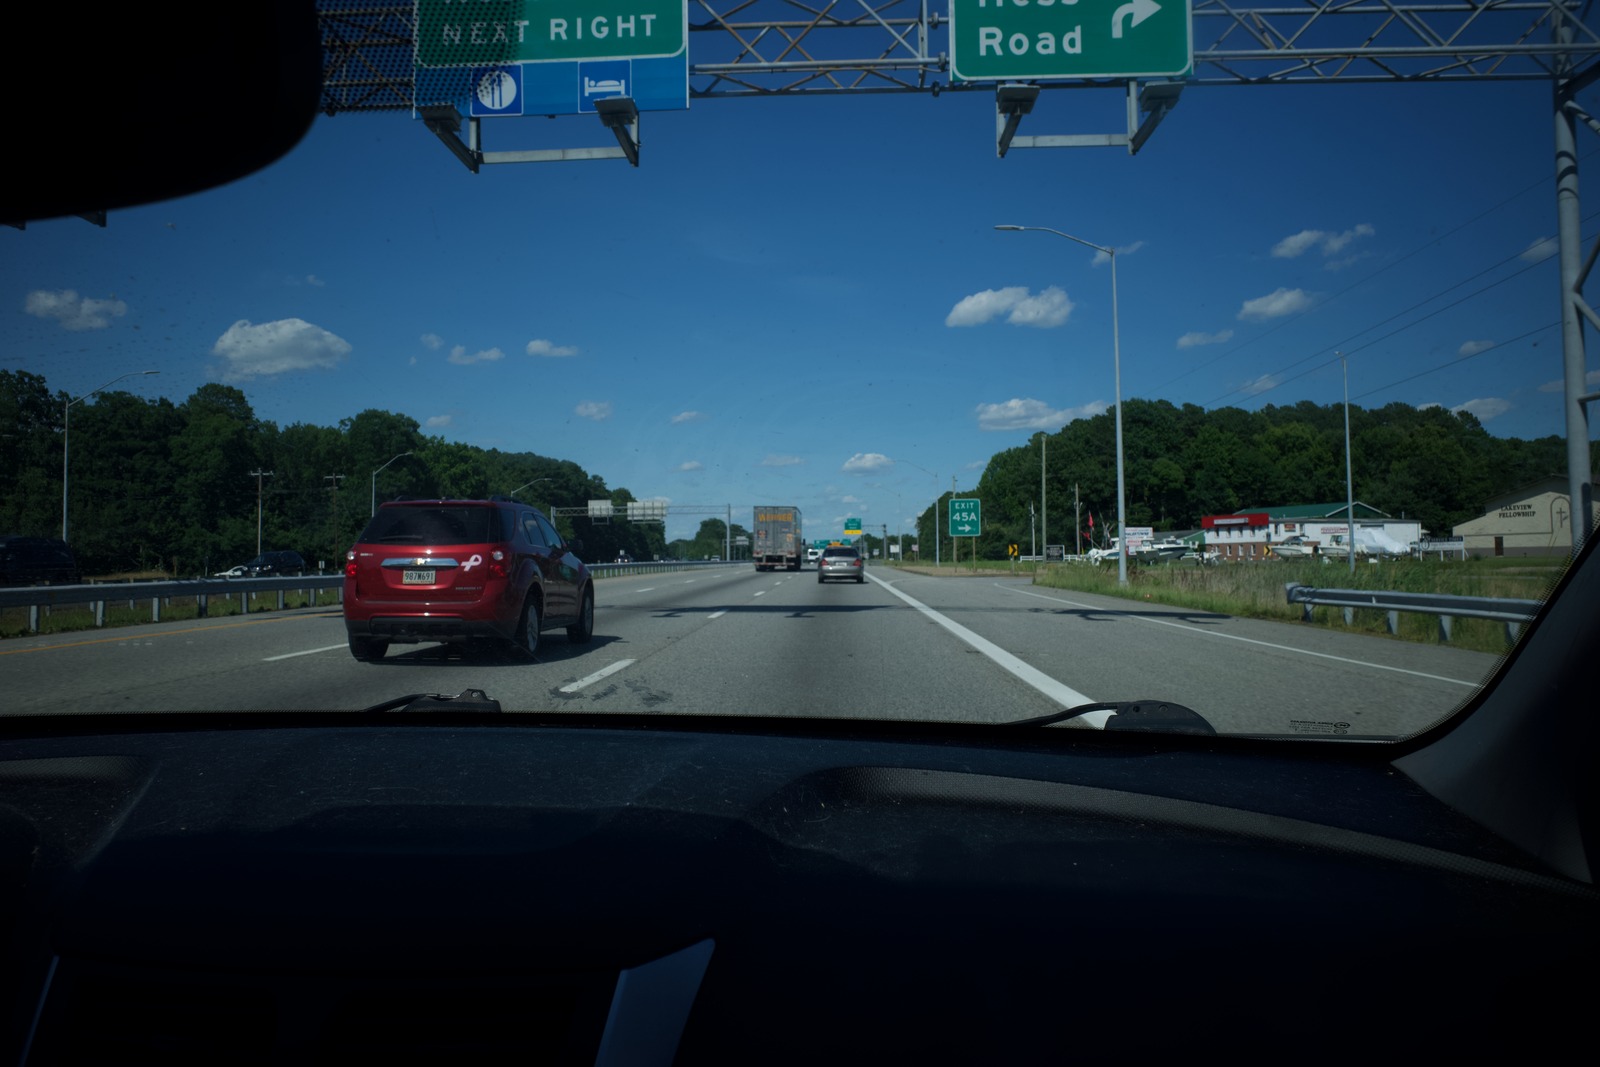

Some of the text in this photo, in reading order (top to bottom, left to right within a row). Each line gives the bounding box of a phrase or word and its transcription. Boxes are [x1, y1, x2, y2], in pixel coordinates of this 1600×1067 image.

[442, 14, 657, 46] NEXT RIGHT
[979, 25, 1082, 57] Road
[955, 502, 974, 510] EXIT
[1500, 503, 1533, 511] LAKEVIEW
[952, 511, 977, 522] 45A
[1498, 510, 1537, 519] FELLOWSHIP
[404, 572, 434, 581] 987M691
